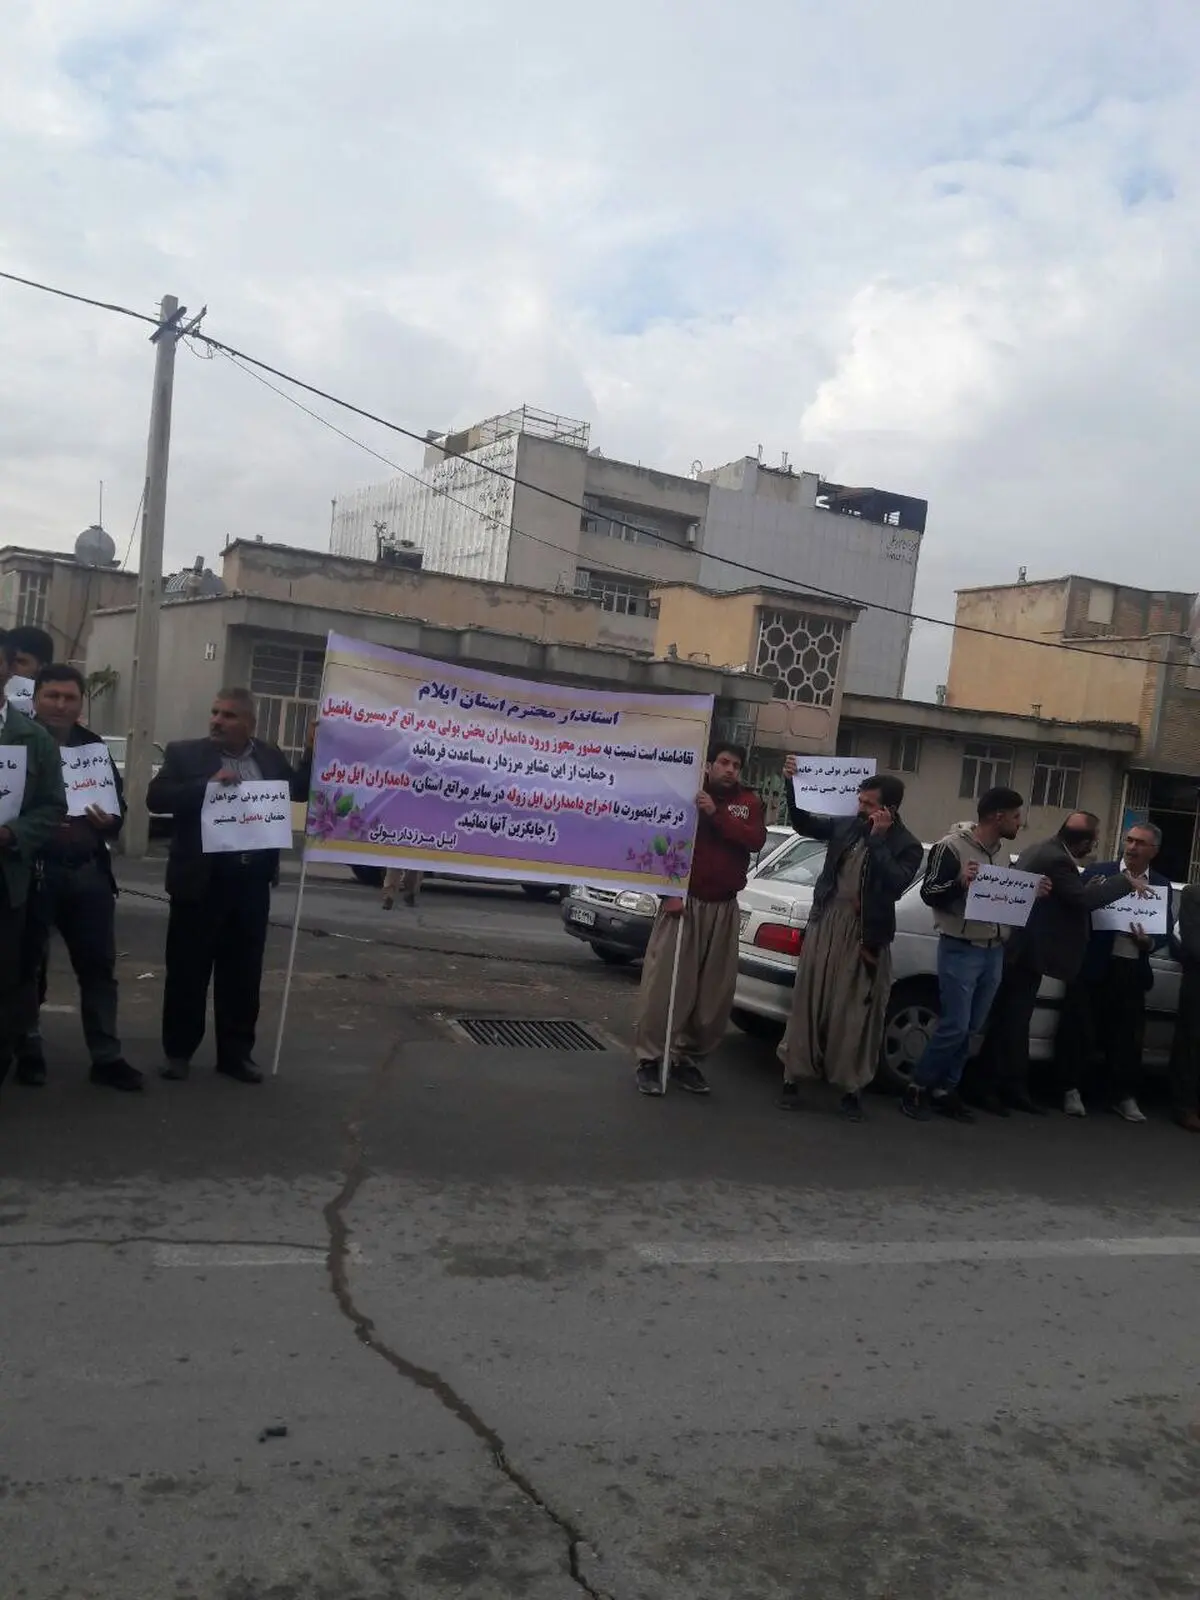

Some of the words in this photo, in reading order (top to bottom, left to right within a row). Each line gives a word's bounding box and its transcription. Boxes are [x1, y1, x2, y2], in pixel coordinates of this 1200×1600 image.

[418, 681, 457, 704] ایلام
[459, 692, 506, 712] استان
[353, 708, 400, 727] گرمسیری
[507, 703, 556, 719] محترم
[558, 709, 620, 725] استاندار
[400, 711, 426, 731] مراتع
[427, 719, 437, 733] به
[438, 719, 460, 738] بولی
[461, 724, 485, 741] بخش
[486, 727, 527, 745] دامداران
[528, 734, 550, 752] ورود
[551, 738, 575, 754] مجوز
[576, 743, 602, 756] صدور
[448, 748, 485, 763] مساعدت
[603, 744, 612, 759] به
[613, 744, 637, 760] نسبت
[638, 747, 657, 760] است
[658, 749, 694, 765] تقاضامند
[321, 762, 346, 783] بولی
[525, 759, 550, 775] عشایر
[550, 763, 566, 779] این
[567, 765, 577, 780] از
[577, 766, 606, 782] حمایت
[347, 766, 364, 785] ایل
[365, 769, 410, 788] دامداران
[607, 774, 615, 786] و
[443, 780, 470, 798] مراتع
[470, 784, 491, 800] سایر
[492, 790, 505, 803] در
[839, 785, 860, 794] ودمان
[527, 791, 543, 808] ایل
[544, 792, 584, 812] دامداران
[585, 799, 612, 816] اخراج
[613, 801, 621, 817] با
[621, 804, 658, 820] اینصورت
[656, 808, 672, 823] غیر
[489, 816, 508, 833] آنها
[671, 811, 684, 825] در
[370, 825, 397, 842] بولی
[399, 828, 435, 845] مرزدار
[508, 822, 545, 839] جایگزین
[547, 823, 556, 841] را
[436, 834, 457, 848] ایل
